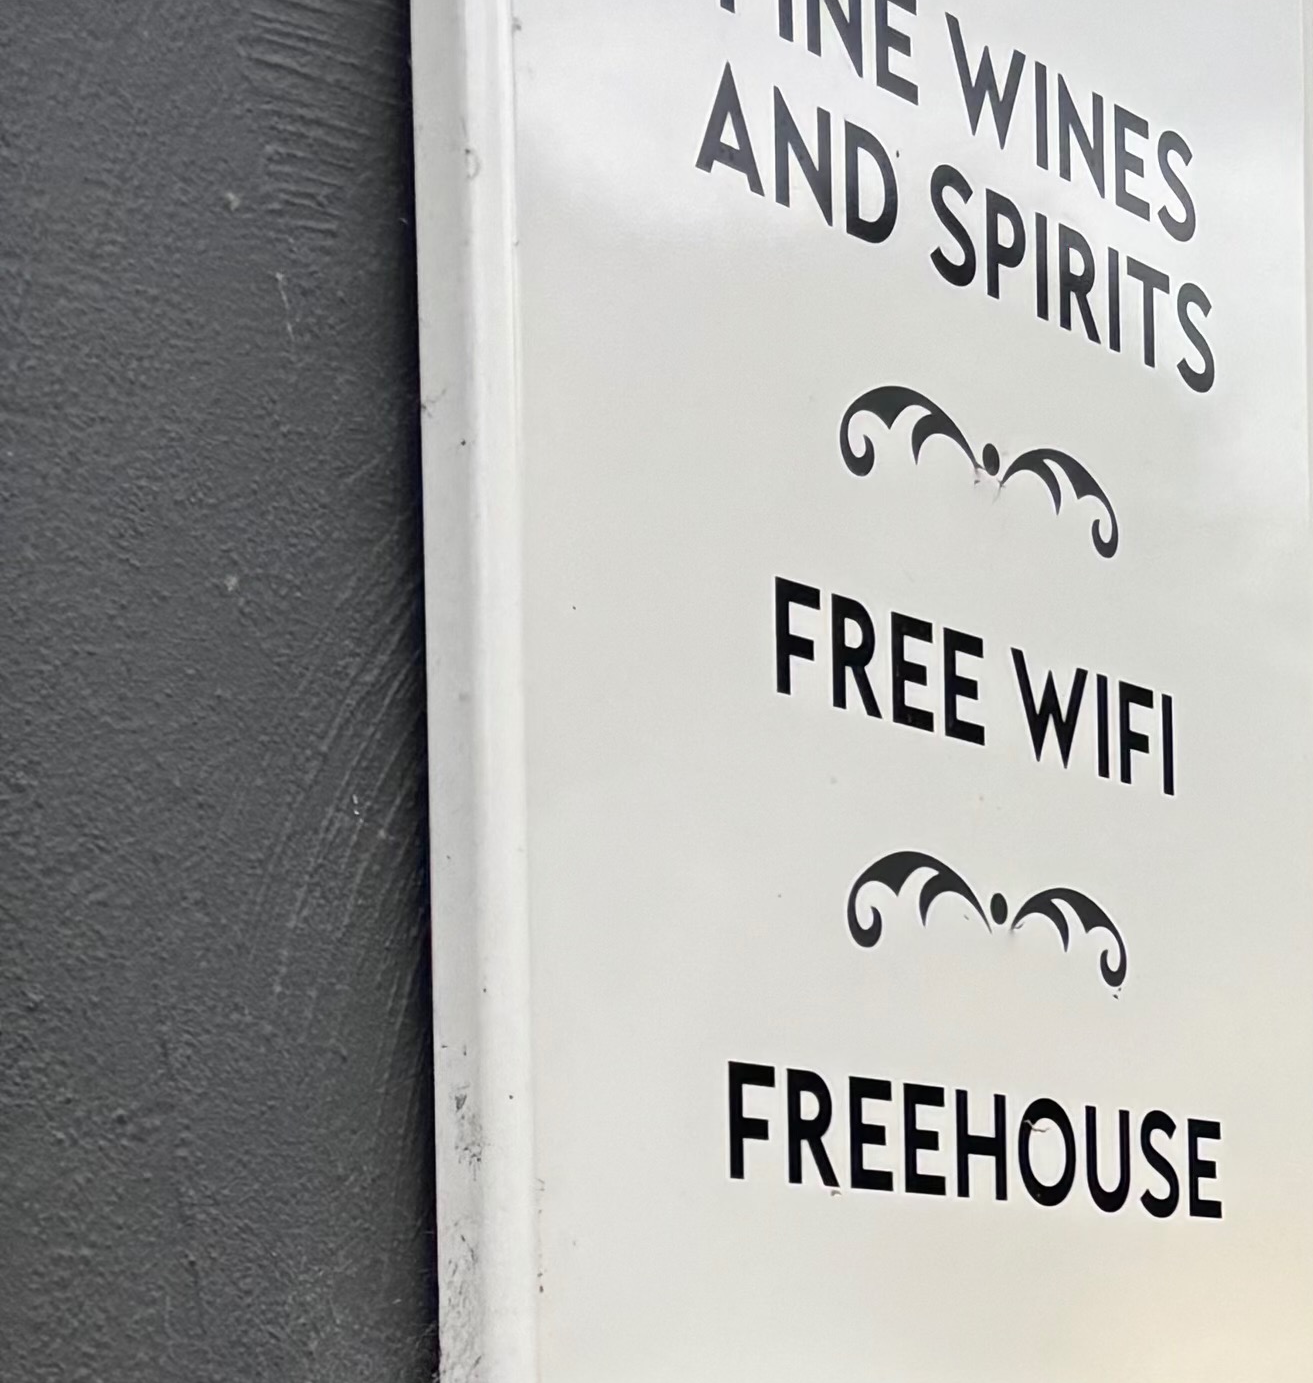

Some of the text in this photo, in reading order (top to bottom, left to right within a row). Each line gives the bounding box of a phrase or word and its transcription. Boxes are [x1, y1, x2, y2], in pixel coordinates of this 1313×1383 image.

[696, 61, 1215, 394] AND SPIRITS
[945, 11, 1197, 243] WINES
[774, 576, 1175, 797] FREE WIFI
[728, 1060, 1223, 1219] FREEHOUSE
